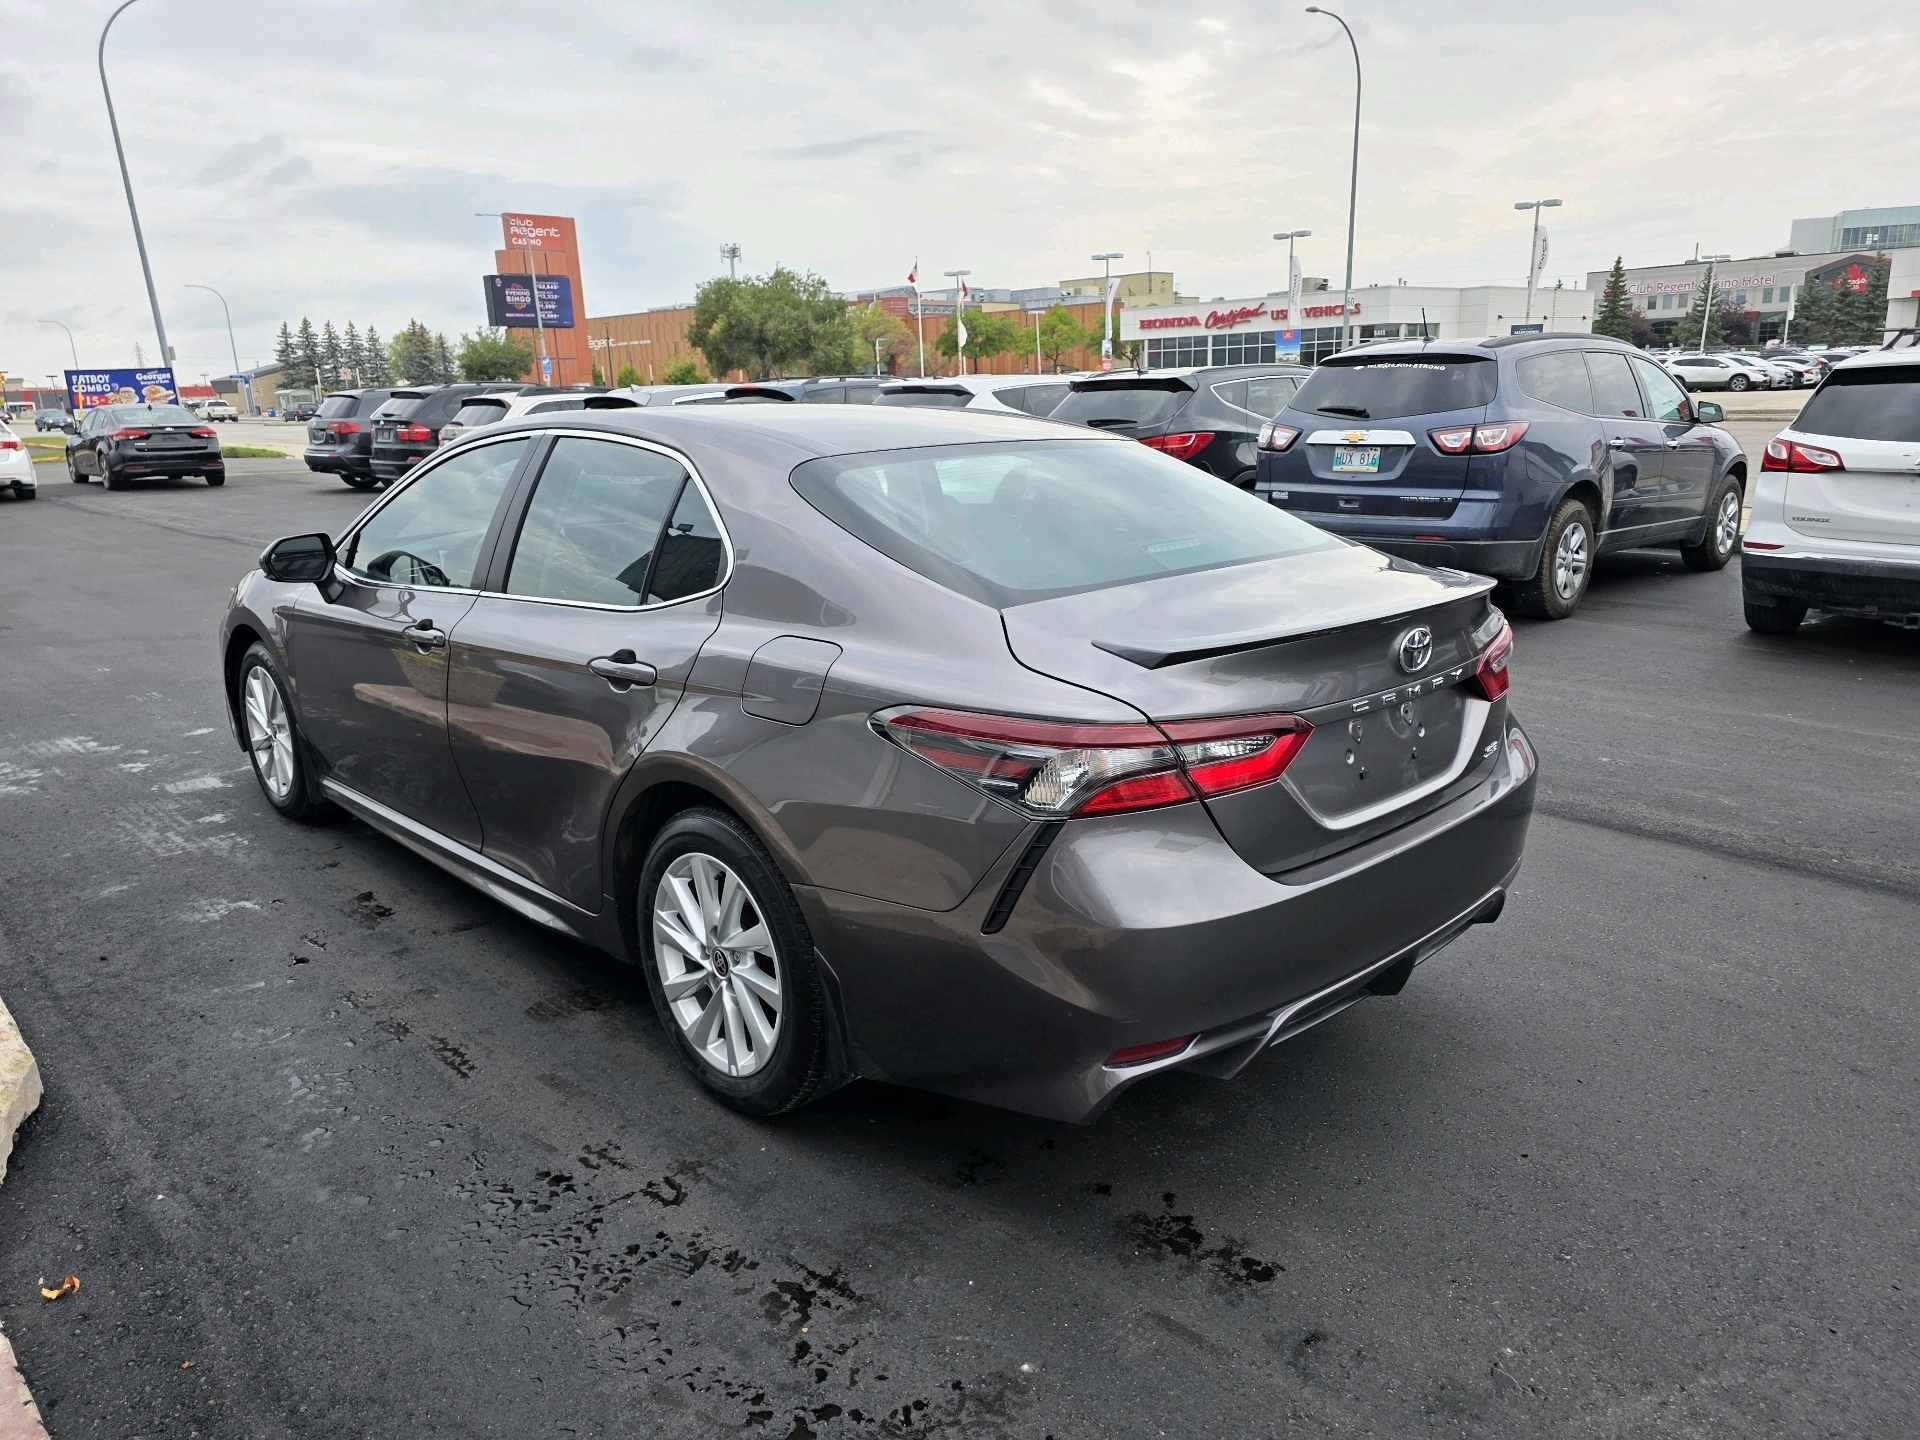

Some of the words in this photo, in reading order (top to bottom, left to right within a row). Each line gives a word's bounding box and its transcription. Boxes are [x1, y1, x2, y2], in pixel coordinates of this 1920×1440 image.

[510, 226, 560, 238] Regent
[511, 236, 542, 246] CASNO
[1628, 283, 1653, 295] Club
[1656, 281, 1696, 295] Regent
[1741, 273, 1777, 287] Hotel
[506, 295, 532, 303] BINGO
[1347, 296, 1355, 307] 60
[1139, 316, 1201, 330] HONDA
[1204, 301, 1268, 329] Certified
[1412, 363, 1446, 371] STRONG
[71, 374, 110, 384] FATBOY
[135, 372, 171, 382] Georges
[71, 383, 111, 393] COMBO
[1335, 452, 1354, 465] HUX
[1359, 452, 1377, 465] 816
[1792, 516, 1831, 524] EQUINOX
[1351, 668, 1463, 713] CAMRY
